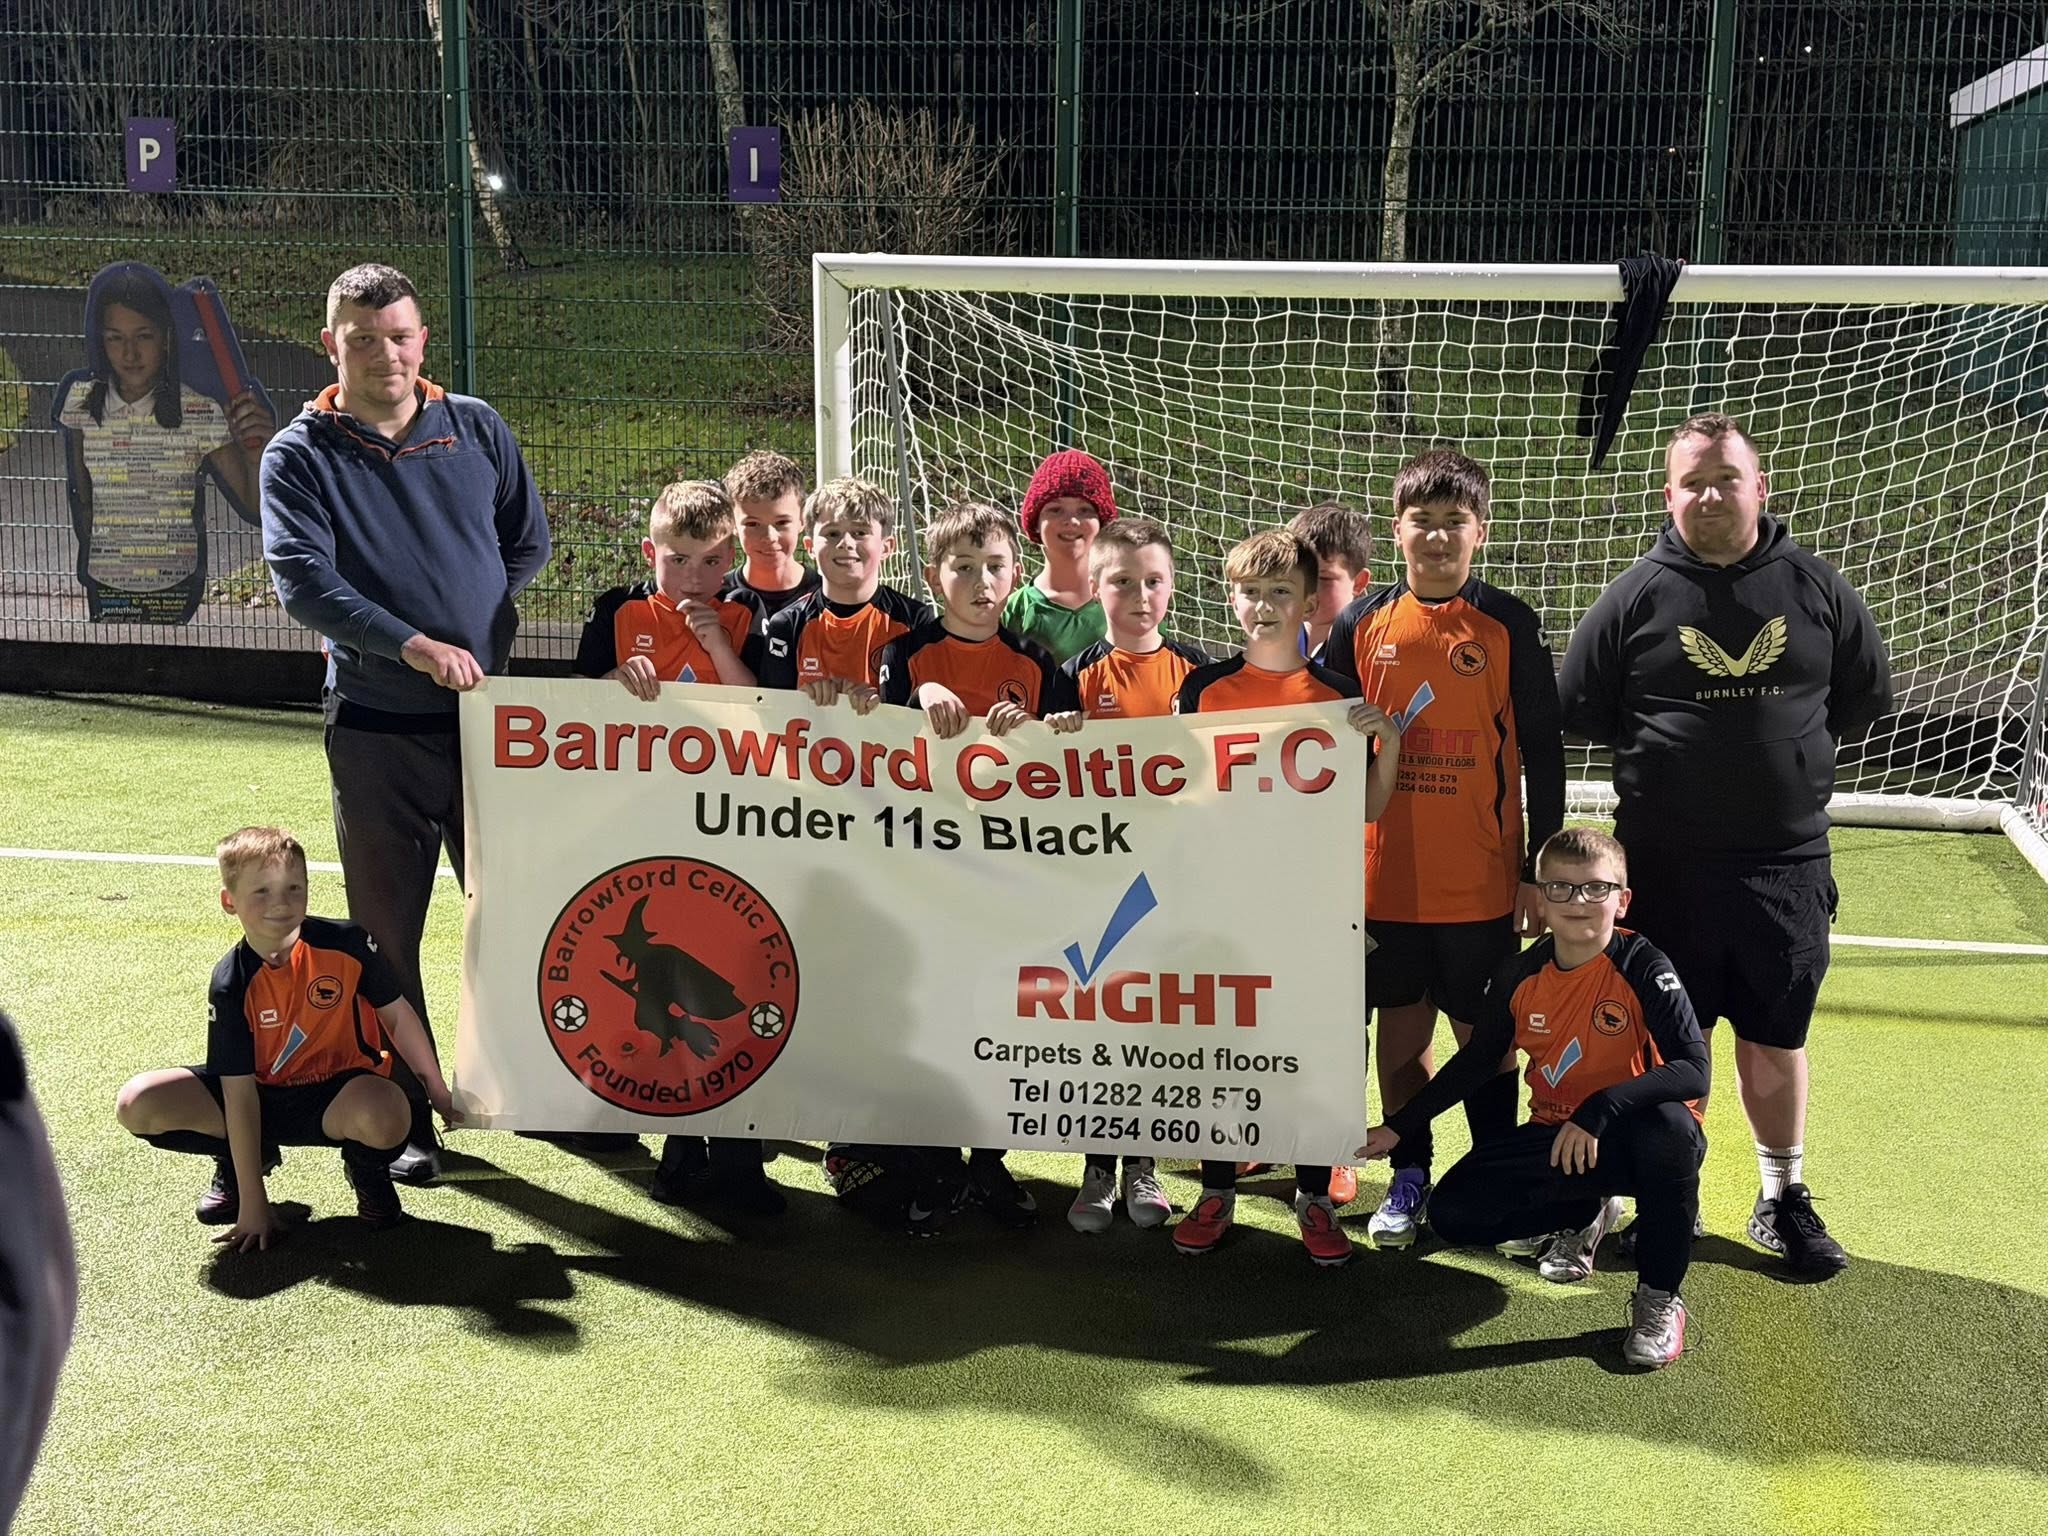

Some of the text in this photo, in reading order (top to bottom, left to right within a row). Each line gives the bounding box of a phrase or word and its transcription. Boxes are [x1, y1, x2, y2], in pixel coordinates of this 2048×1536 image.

[139, 137, 160, 172] P
[749, 147, 758, 182] I
[92, 527, 110, 536] LAP
[101, 606, 142, 616] pentathlon
[1695, 685, 1784, 700] BURNLEY F.C.
[493, 704, 1338, 801] Barrowford Celtic F.C
[1400, 727, 1480, 754] GHT
[1399, 770, 1457, 783] 282 428 579
[1418, 755, 1443, 766] WOOD
[1445, 757, 1476, 768] FLOORS
[1395, 782, 1457, 795] 1254 660 600
[695, 792, 1132, 856] Under 11s Black
[547, 864, 791, 989] Barrowford Celtic F.C.
[1016, 965, 1272, 1027] RIGHT
[577, 1043, 754, 1103] Founded 1970
[973, 1037, 1299, 1074] Carpets & Wood floors
[1009, 1078, 1262, 1112] Tel 01282 428 579
[1007, 1112, 1260, 1147] Tel 01254 660 600
